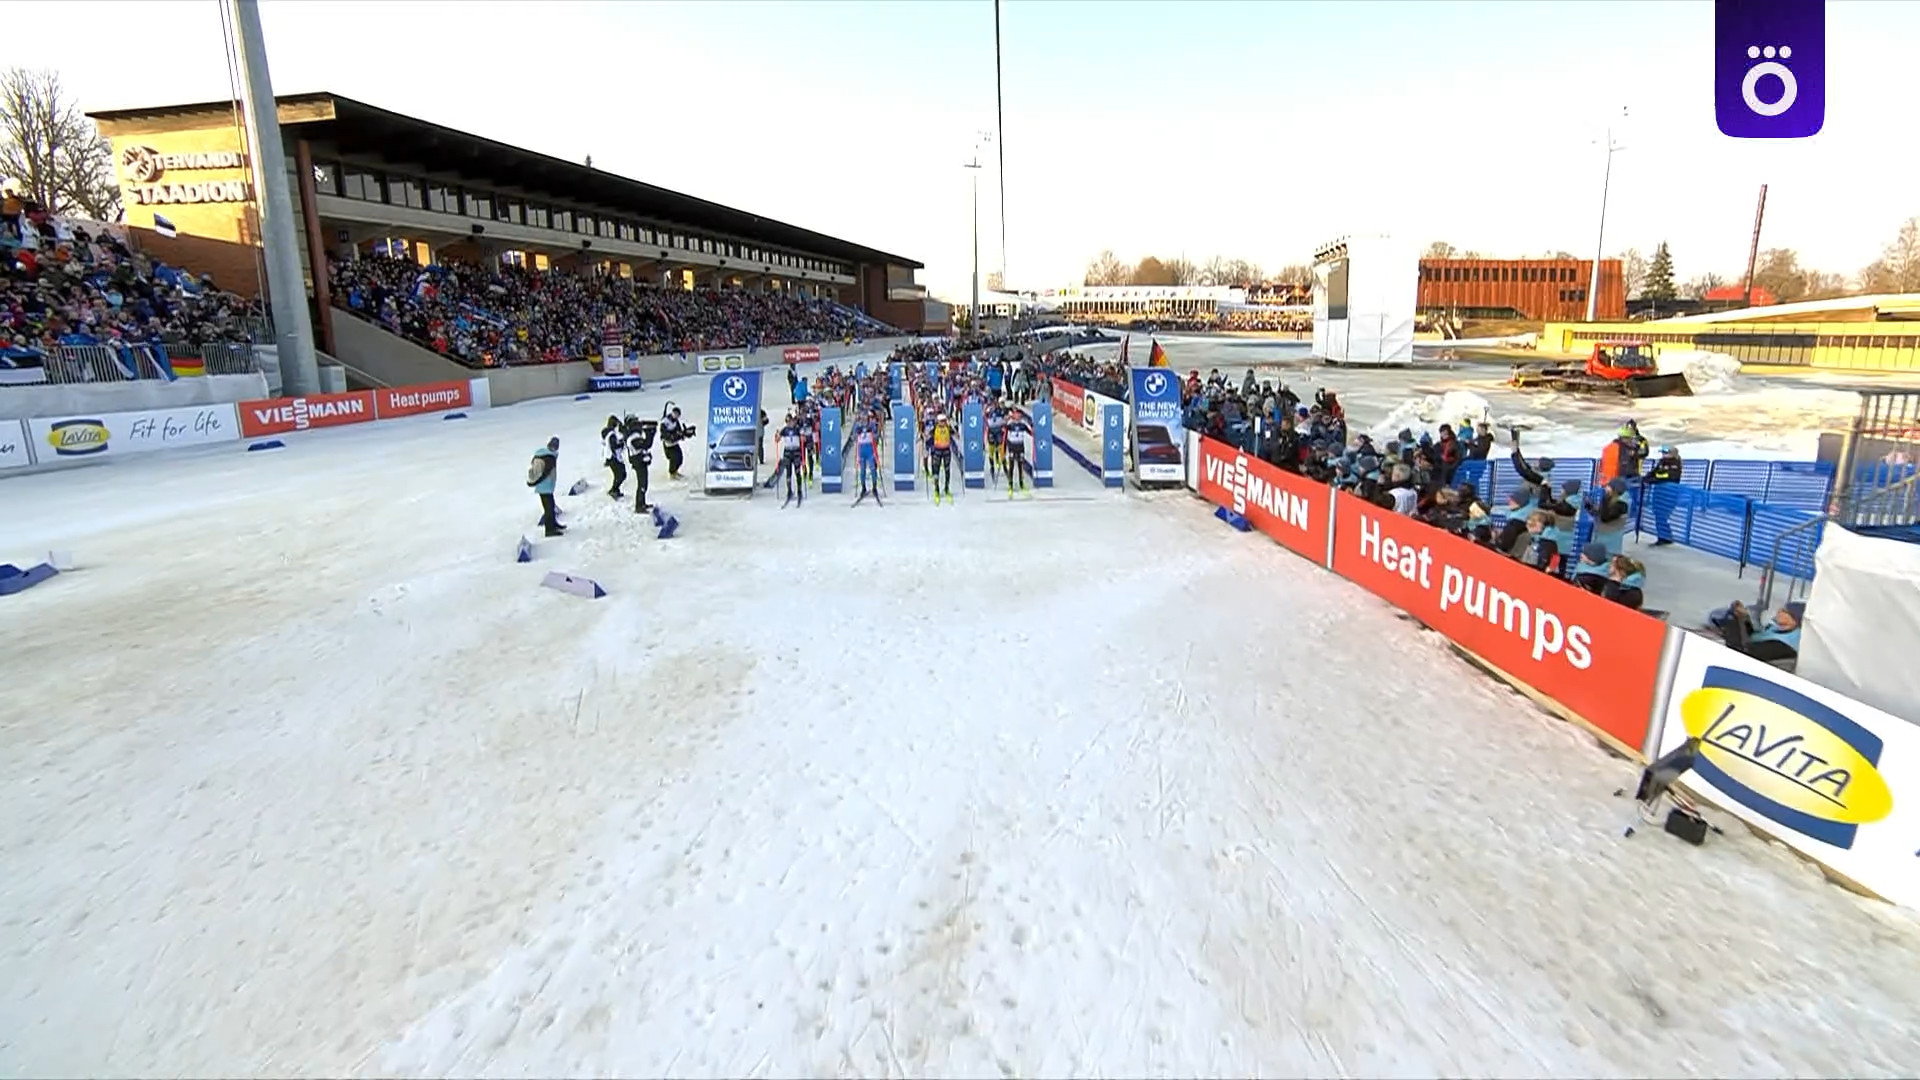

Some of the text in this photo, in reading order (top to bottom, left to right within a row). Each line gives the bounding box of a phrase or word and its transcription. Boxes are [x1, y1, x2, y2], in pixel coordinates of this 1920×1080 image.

[128, 181, 245, 203] STAADION
[390, 388, 460, 408] Heat pumps
[713, 405, 753, 416] THE NEW
[1138, 401, 1177, 410] THE NEW
[254, 398, 364, 430] VIESSMANN
[713, 416, 735, 424] BMW
[130, 410, 222, 441] Fit for life
[827, 420, 834, 431] 1
[900, 417, 908, 429] 2
[969, 416, 977, 427] 3
[1038, 415, 1046, 427] 4
[1110, 415, 1118, 427] 5
[1205, 453, 1309, 532] VIESSMANN
[1360, 514, 1593, 670] Heat pumps
